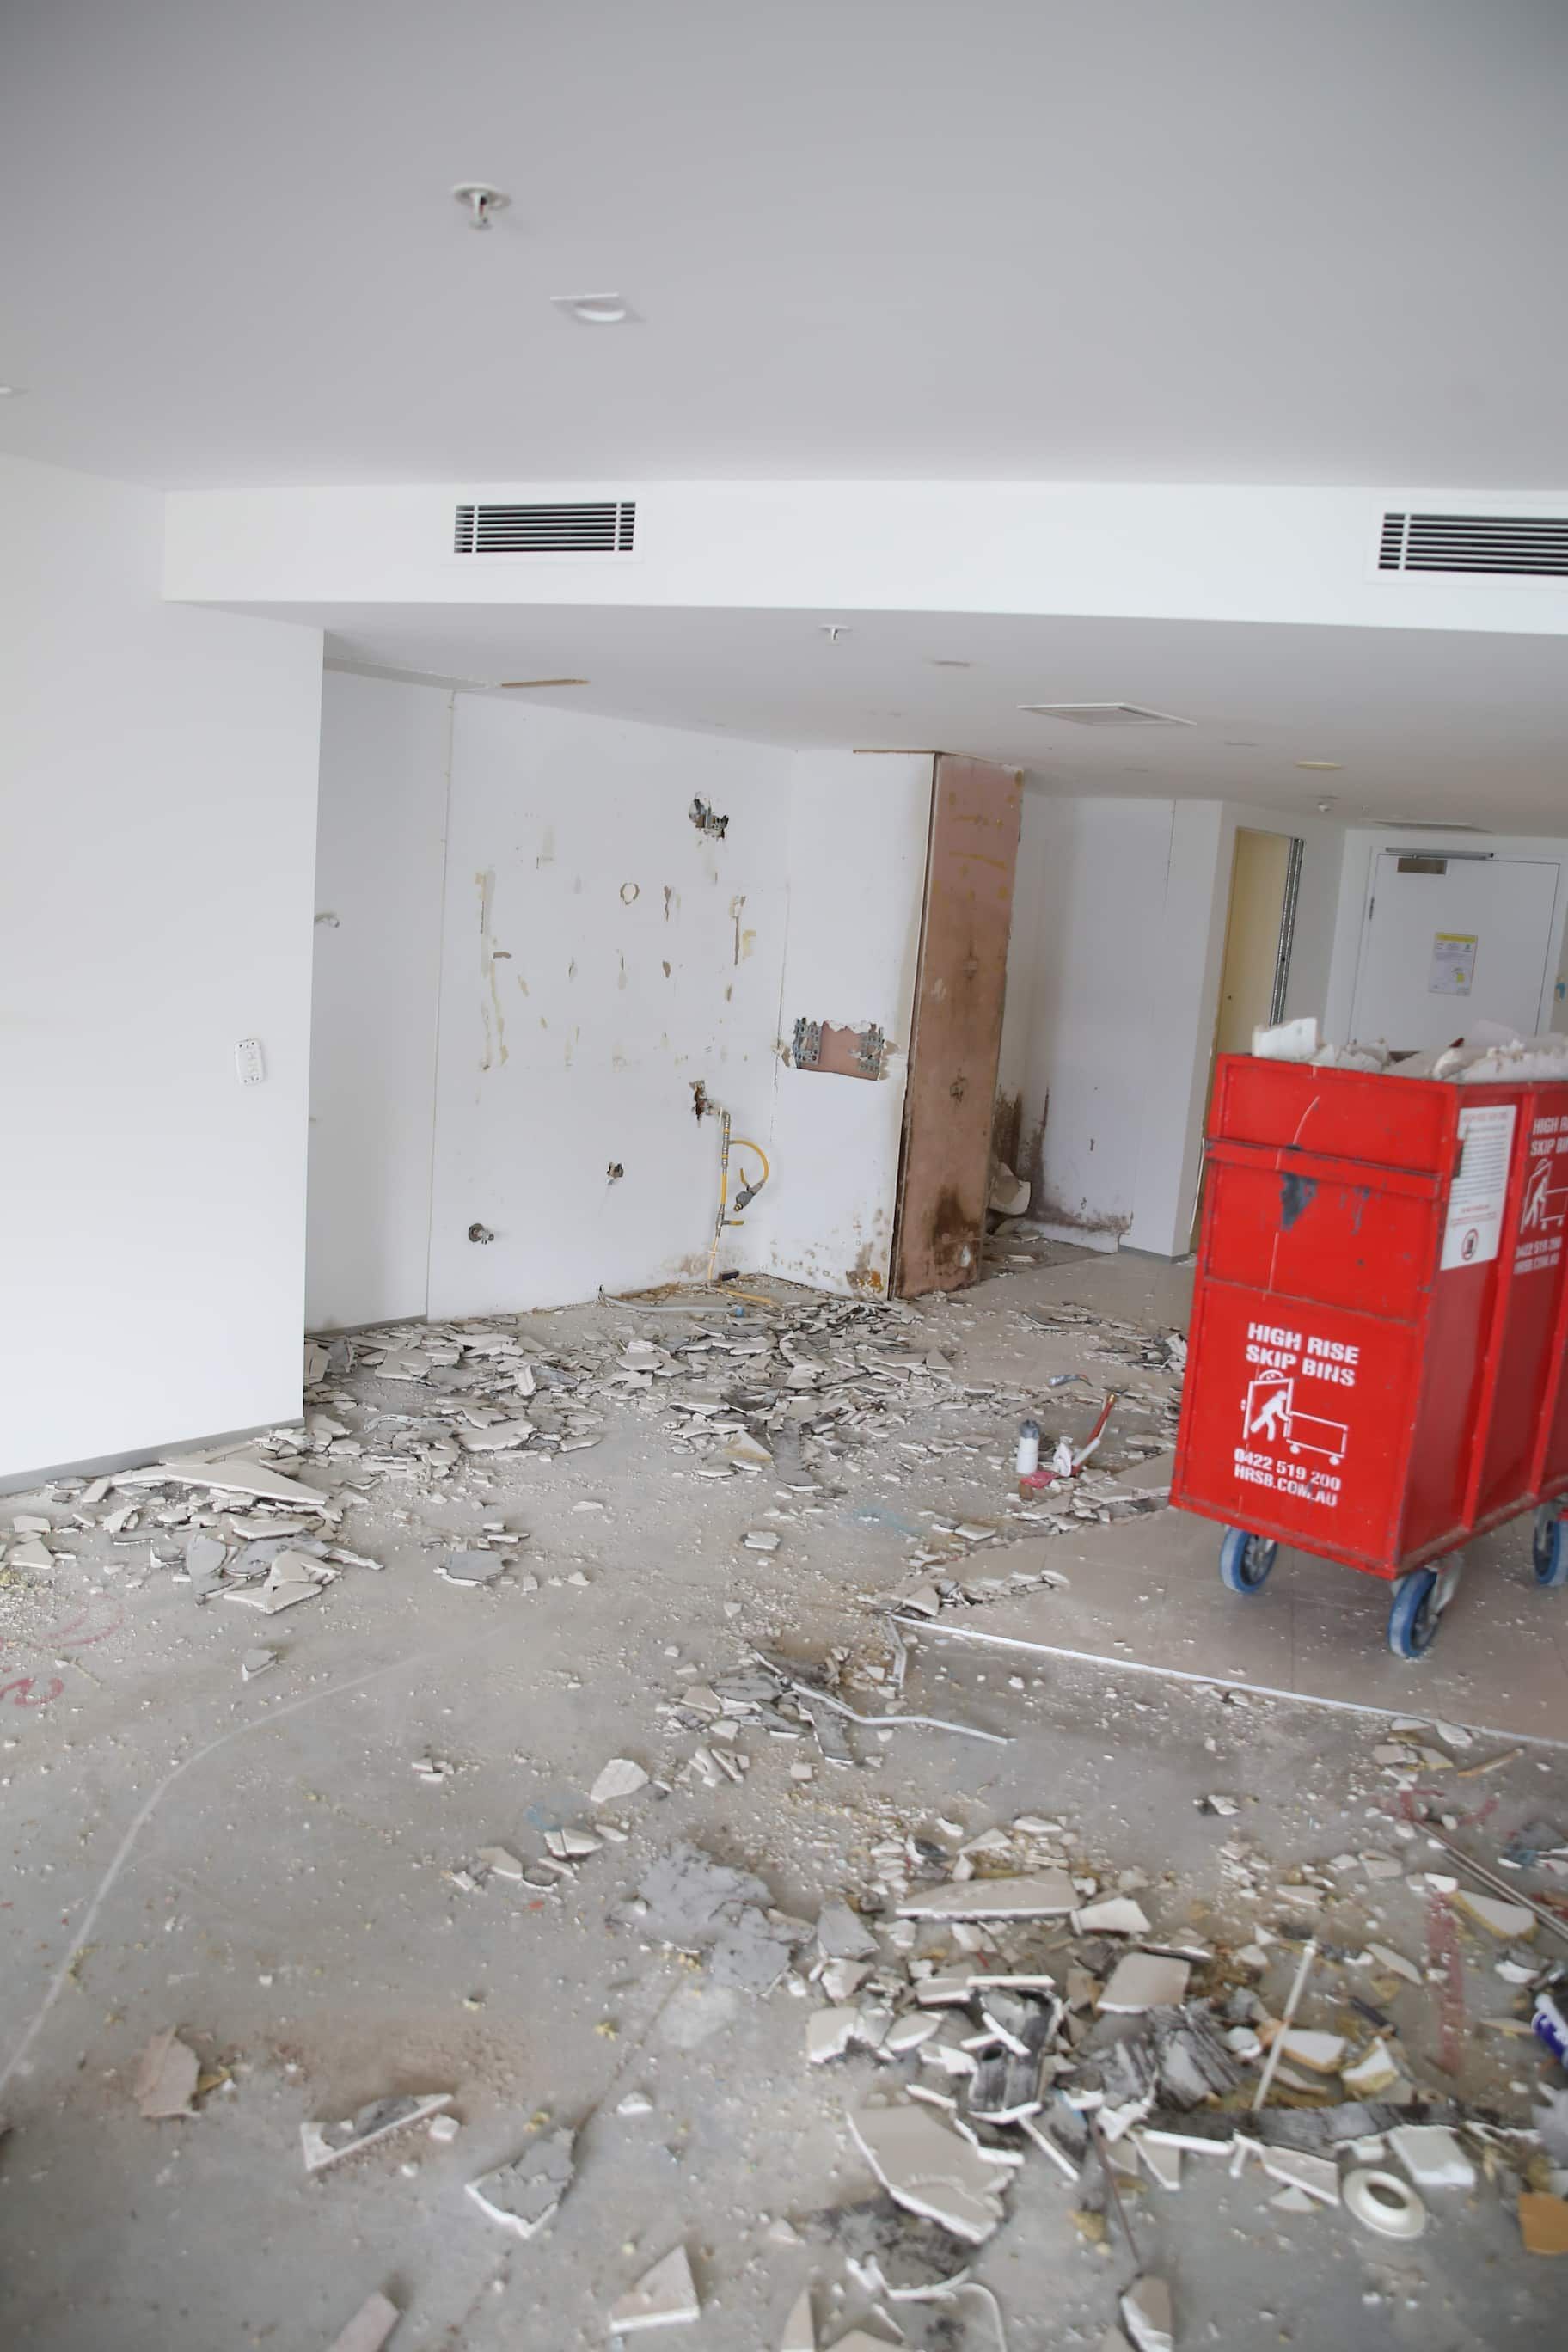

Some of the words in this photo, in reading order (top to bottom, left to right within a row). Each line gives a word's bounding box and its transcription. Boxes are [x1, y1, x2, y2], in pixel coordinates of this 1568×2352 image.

[1530, 1139, 1555, 1156] SKIP
[1533, 1117, 1559, 1135] HIGH
[1247, 1322, 1302, 1351] HIGH
[1307, 1336, 1360, 1365] RISE
[1246, 1344, 1297, 1369] SKIP
[1302, 1357, 1356, 1387] BINS
[1234, 1448, 1274, 1471] 0422
[1276, 1460, 1306, 1480] 519
[1310, 1471, 1342, 1491] 200
[1234, 1463, 1338, 1507] HRSB.COM.AU
